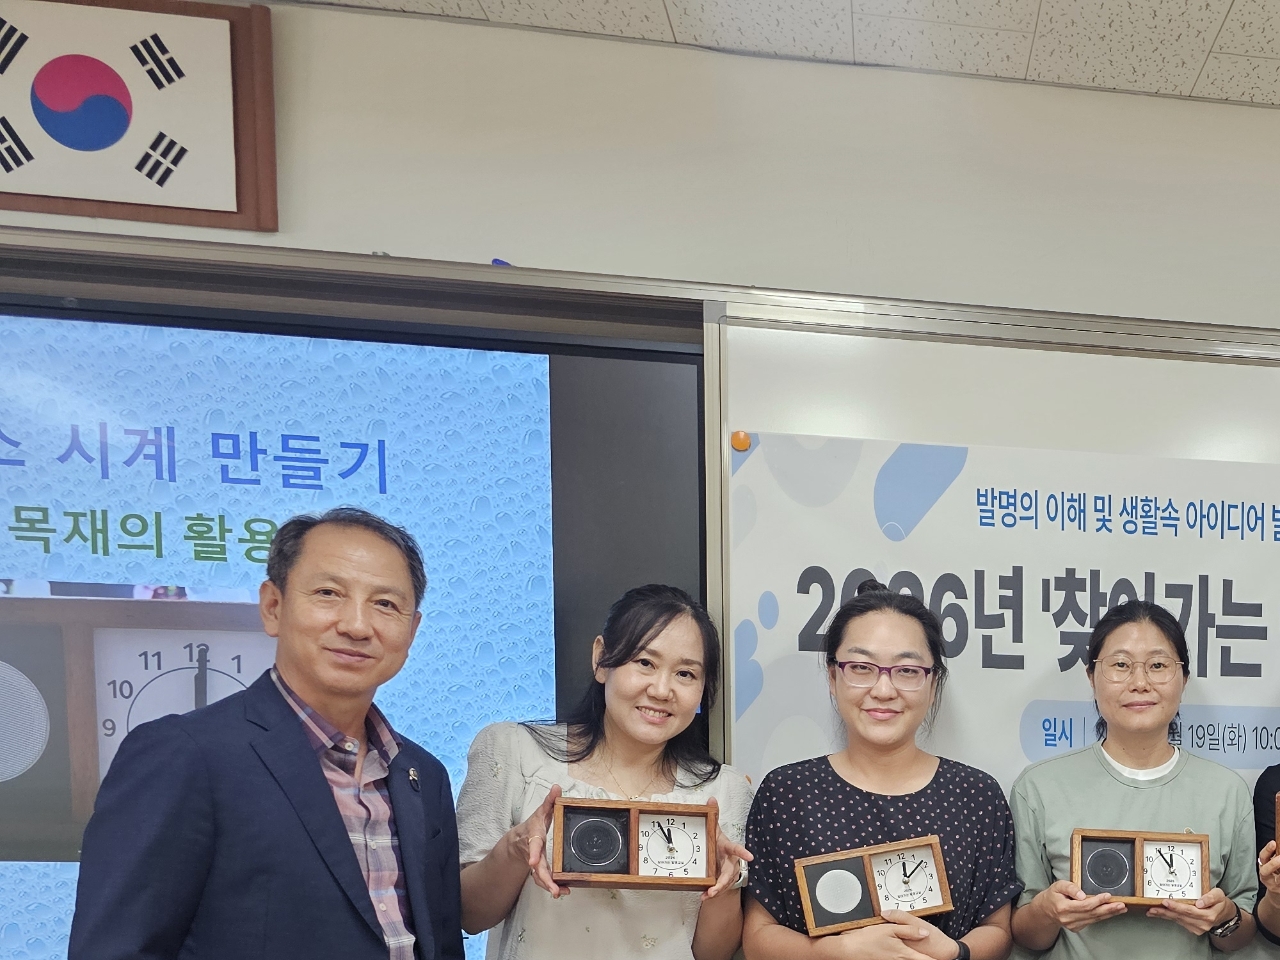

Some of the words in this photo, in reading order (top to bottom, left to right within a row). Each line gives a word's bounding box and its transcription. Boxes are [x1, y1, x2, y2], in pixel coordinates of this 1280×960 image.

[56, 422, 178, 483] 시계
[210, 430, 389, 494] 만들기
[976, 487, 1039, 530] 발명의
[1046, 492, 1087, 533] 이해
[1093, 495, 1113, 534] 및
[1119, 495, 1180, 538] 생활속
[1186, 499, 1266, 542] 아이디어
[8, 504, 165, 560] 목재의
[184, 512, 279, 564] 활용
[796, 565, 1025, 671] 26년
[138, 650, 163, 671] 11
[231, 655, 242, 675] 1
[107, 680, 134, 700] 10
[102, 718, 117, 738] 9
[1042, 716, 1073, 748] 일시
[1168, 721, 1182, 746] 월
[1188, 722, 1247, 753] 19일(화)
